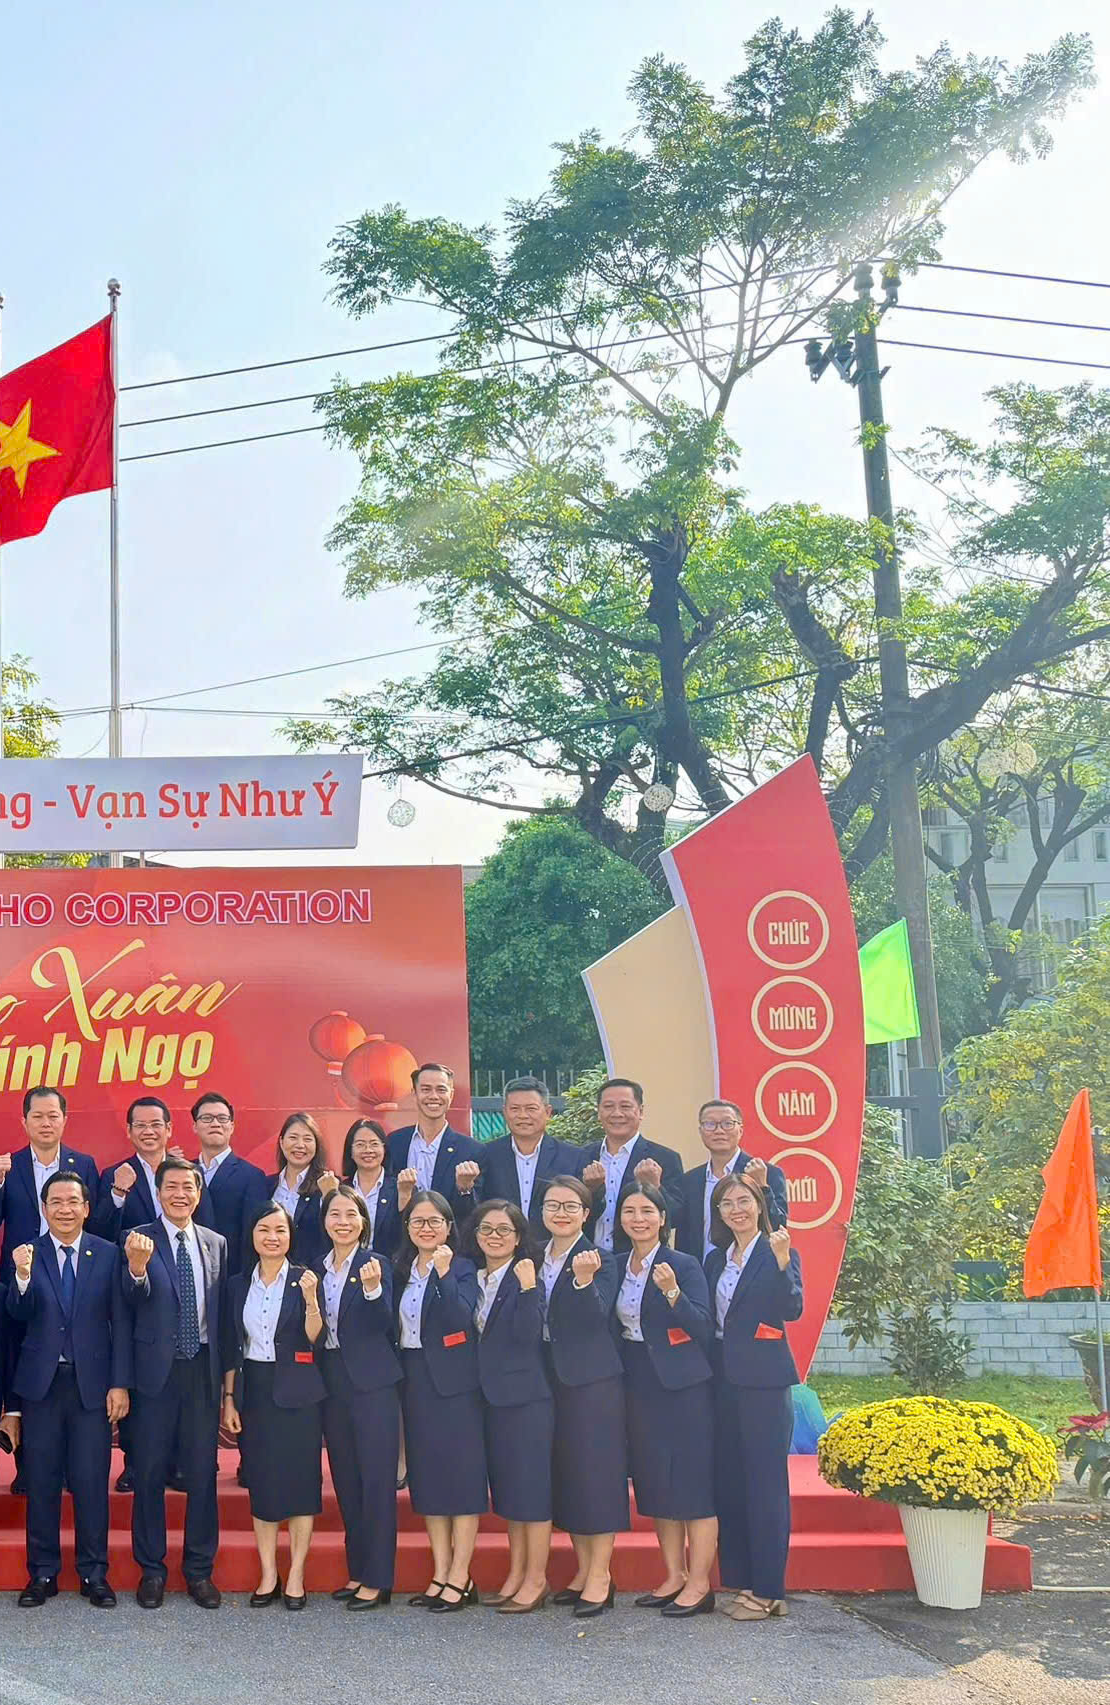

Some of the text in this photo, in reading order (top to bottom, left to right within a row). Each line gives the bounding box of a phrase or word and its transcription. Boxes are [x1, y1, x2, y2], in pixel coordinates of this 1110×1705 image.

[67, 784, 147, 830] Vạn
[158, 783, 211, 829] Sự
[218, 780, 306, 818] Như
[312, 770, 339, 817] Ý
[64, 889, 372, 927] CORPORATION
[767, 918, 810, 945] CHÚC
[31, 938, 243, 1043] Xuân
[768, 1003, 818, 1031] MỪNG
[97, 1025, 215, 1090] Ngọ
[777, 1088, 816, 1116] NĂM
